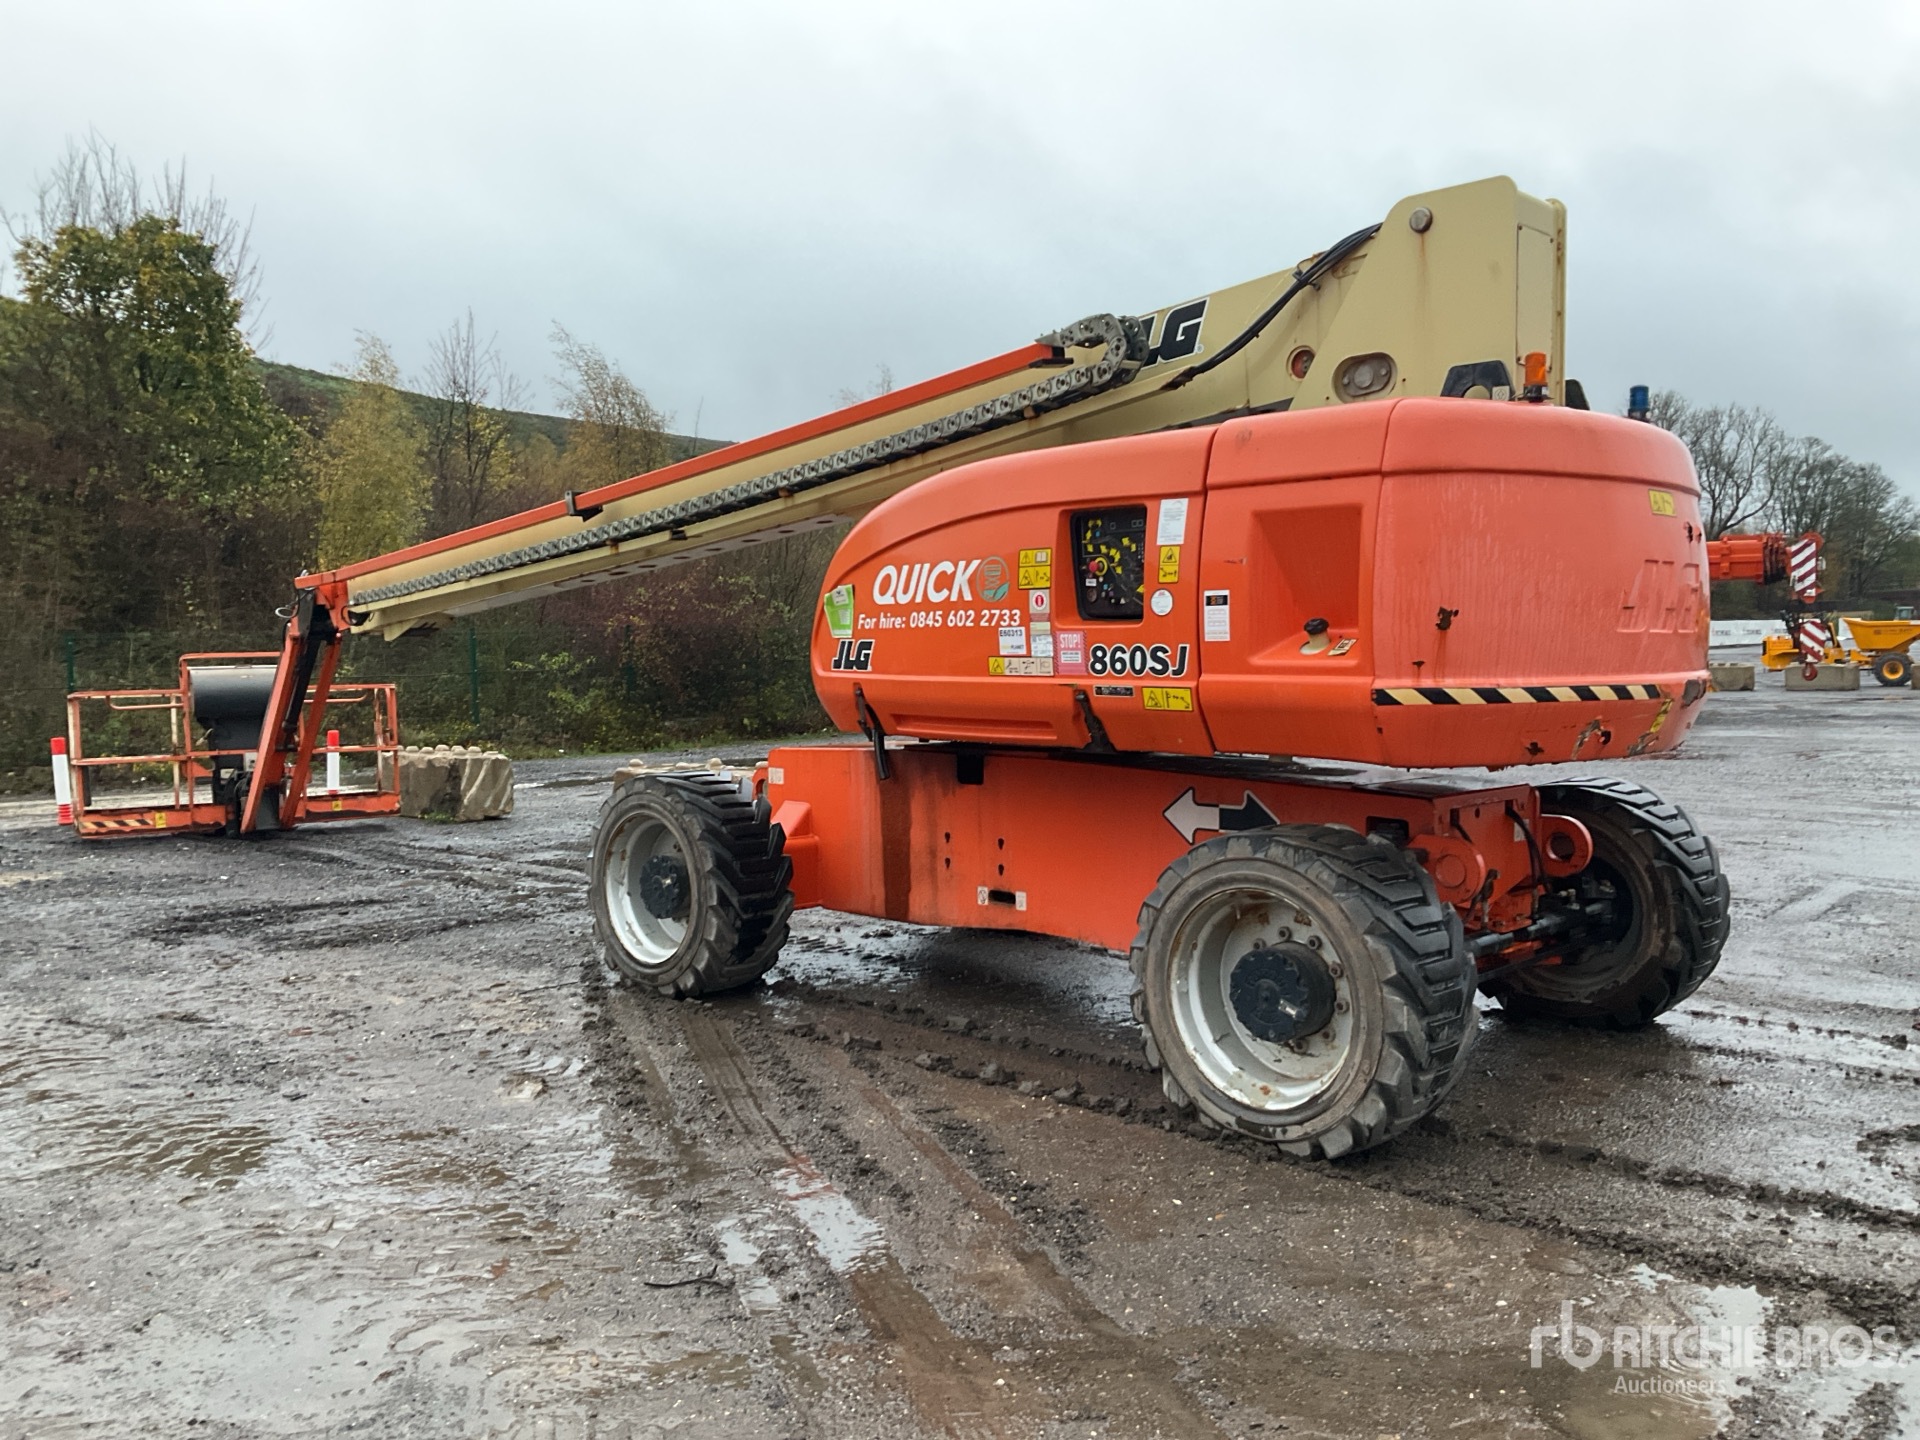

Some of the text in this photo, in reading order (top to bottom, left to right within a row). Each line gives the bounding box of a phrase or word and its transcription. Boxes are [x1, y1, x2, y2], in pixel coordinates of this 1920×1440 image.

[872, 559, 981, 605] QUICK
[857, 613, 877, 630] For
[879, 612, 906, 629] hire:
[909, 611, 943, 628] 0845
[947, 610, 975, 627] 602
[979, 609, 1021, 626] 2733
[831, 639, 875, 672] JLG
[1059, 633, 1082, 649] STOP!
[1089, 643, 1190, 678] 860SJ
